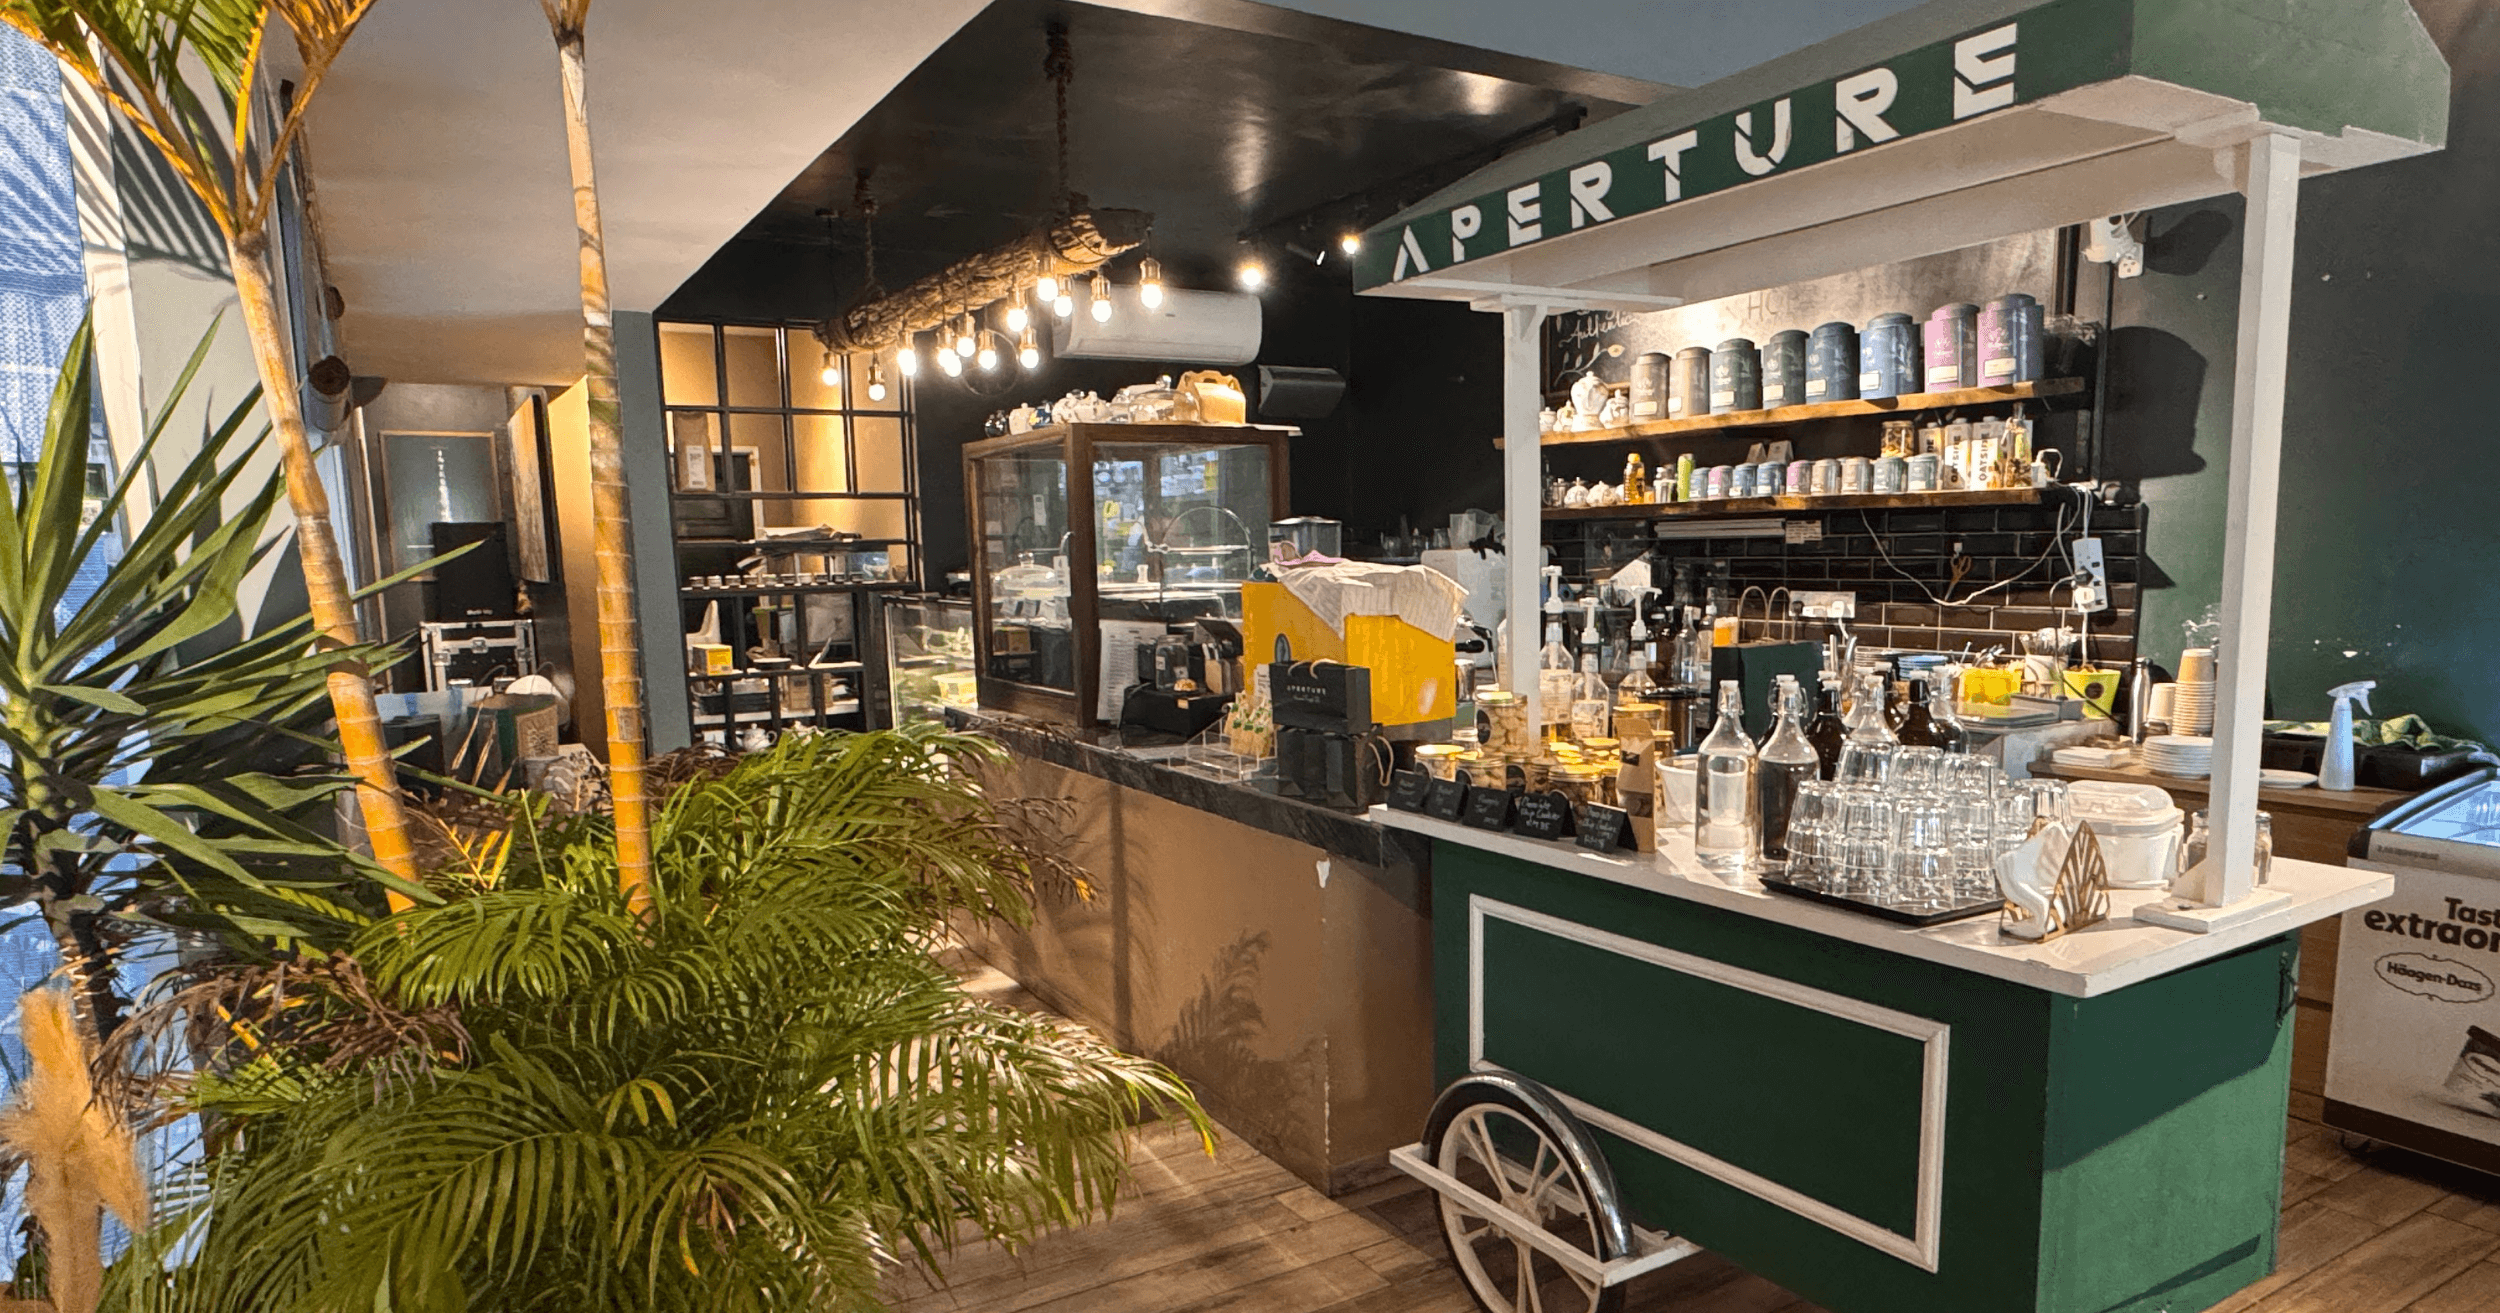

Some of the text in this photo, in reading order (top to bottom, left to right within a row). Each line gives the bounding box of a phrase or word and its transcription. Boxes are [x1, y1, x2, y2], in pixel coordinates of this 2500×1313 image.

[1393, 22, 2018, 282] APERTURE
[1979, 432, 1990, 482] OATSIDE
[2364, 909, 2500, 953] extraor
